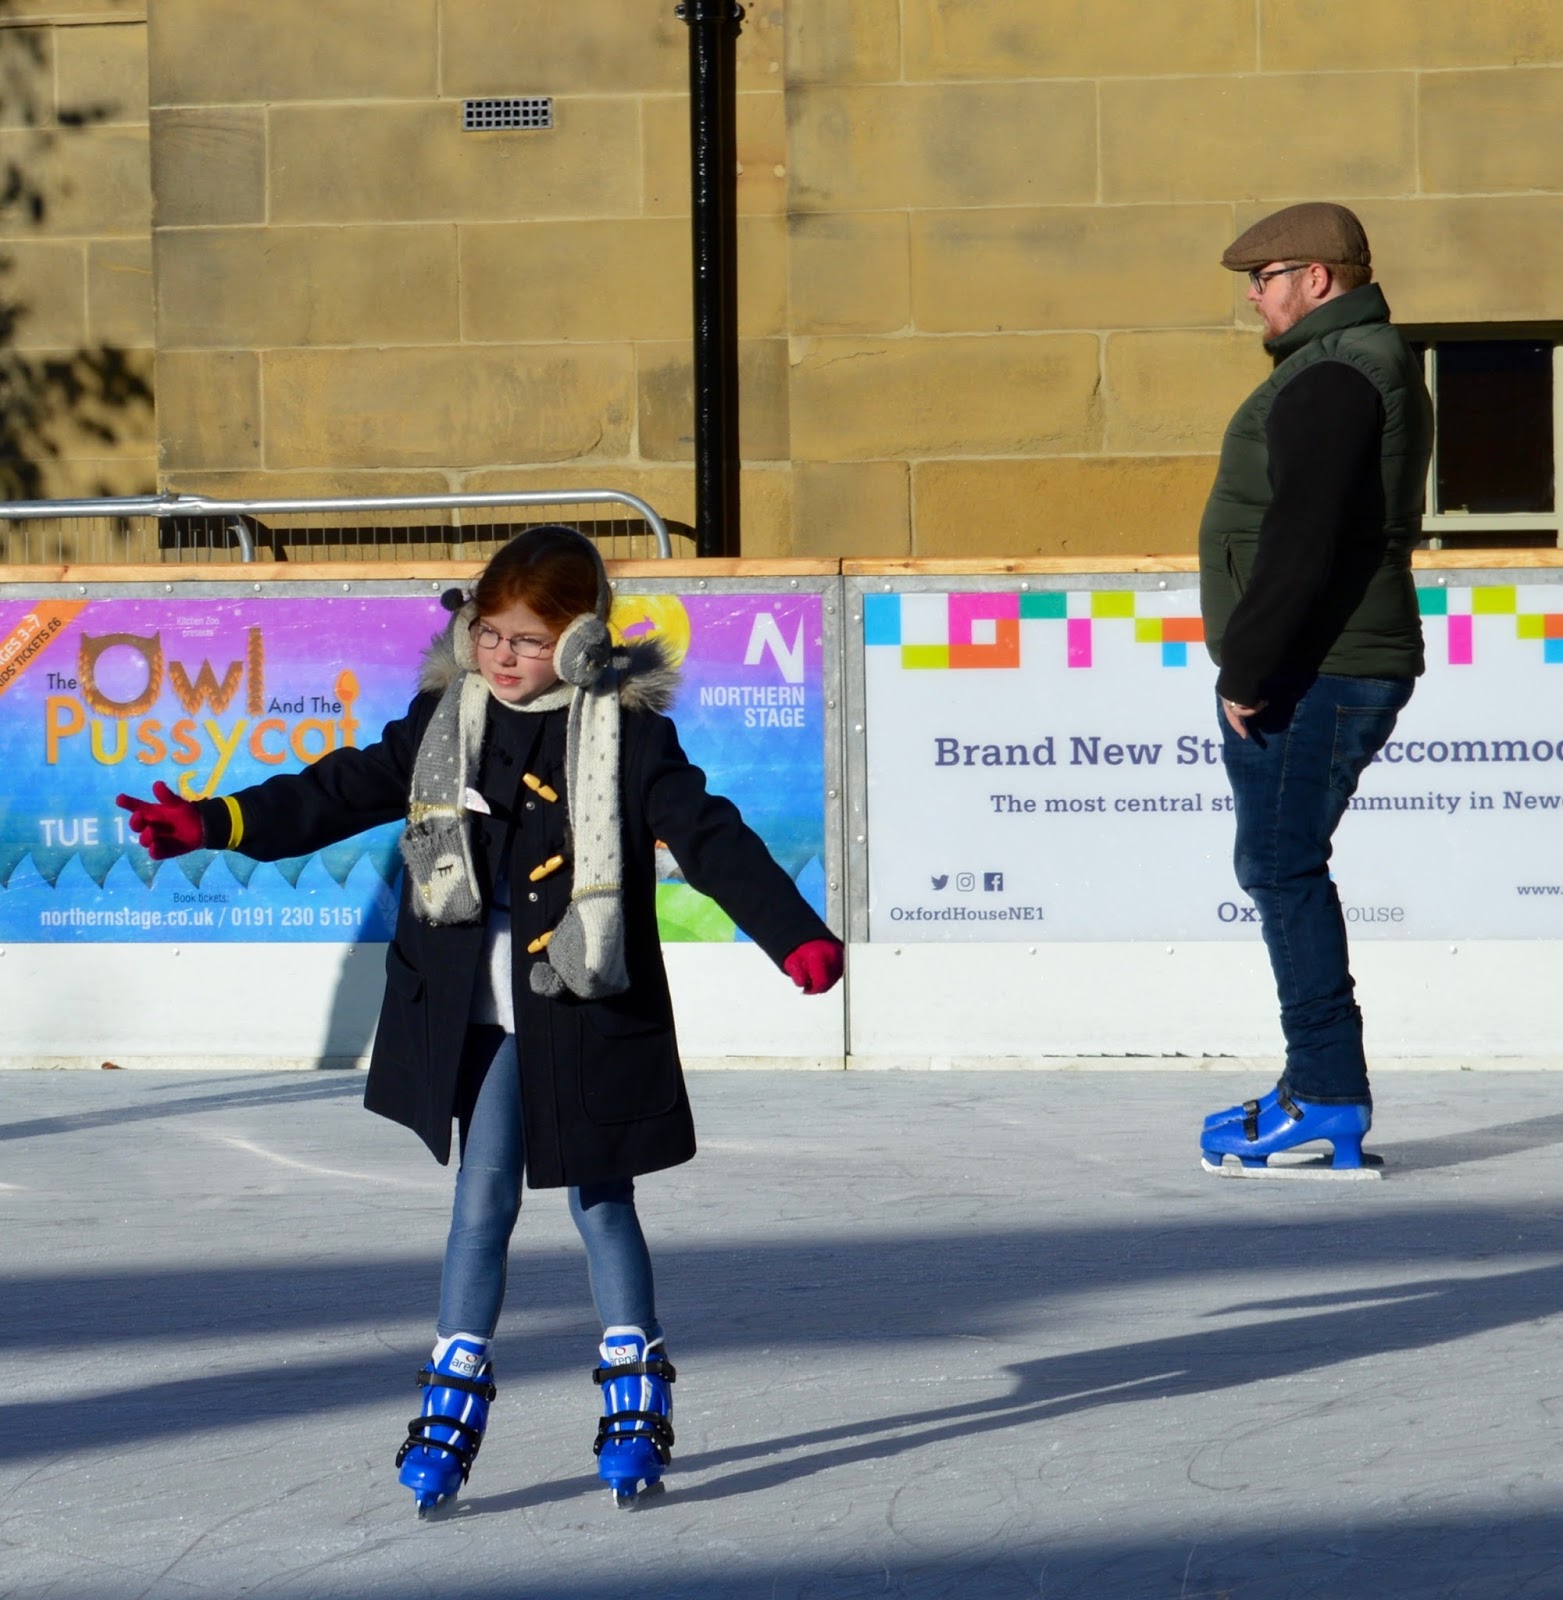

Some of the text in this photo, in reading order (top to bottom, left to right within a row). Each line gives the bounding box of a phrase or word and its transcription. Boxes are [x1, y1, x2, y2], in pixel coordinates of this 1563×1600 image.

[206, 616, 220, 626] Zoo
[183, 629, 214, 638] presents
[0, 638, 21, 665] GES
[0, 617, 61, 687] IDS' TICKETS £6
[47, 627, 265, 718] The Owl
[268, 696, 342, 713] And The
[700, 686, 805, 707] NORTHERN
[744, 708, 805, 728] STAGE
[45, 669, 360, 802] Pussycat
[934, 736, 1056, 766] Brand
[1069, 736, 1162, 765] New
[1176, 735, 1224, 765] St
[990, 791, 1563, 815] The most central st mmunity in New
[39, 817, 99, 847] TUE
[173, 892, 230, 903] Book tickets:
[40, 907, 213, 929] northernstage.co.uk
[231, 907, 273, 926] 0191
[280, 907, 313, 926] 230
[320, 907, 362, 926] 5151
[890, 906, 1044, 922] OxfordHouseNE1
[1217, 902, 1404, 923] Ox ouse
[451, 1358, 477, 1373] aren
